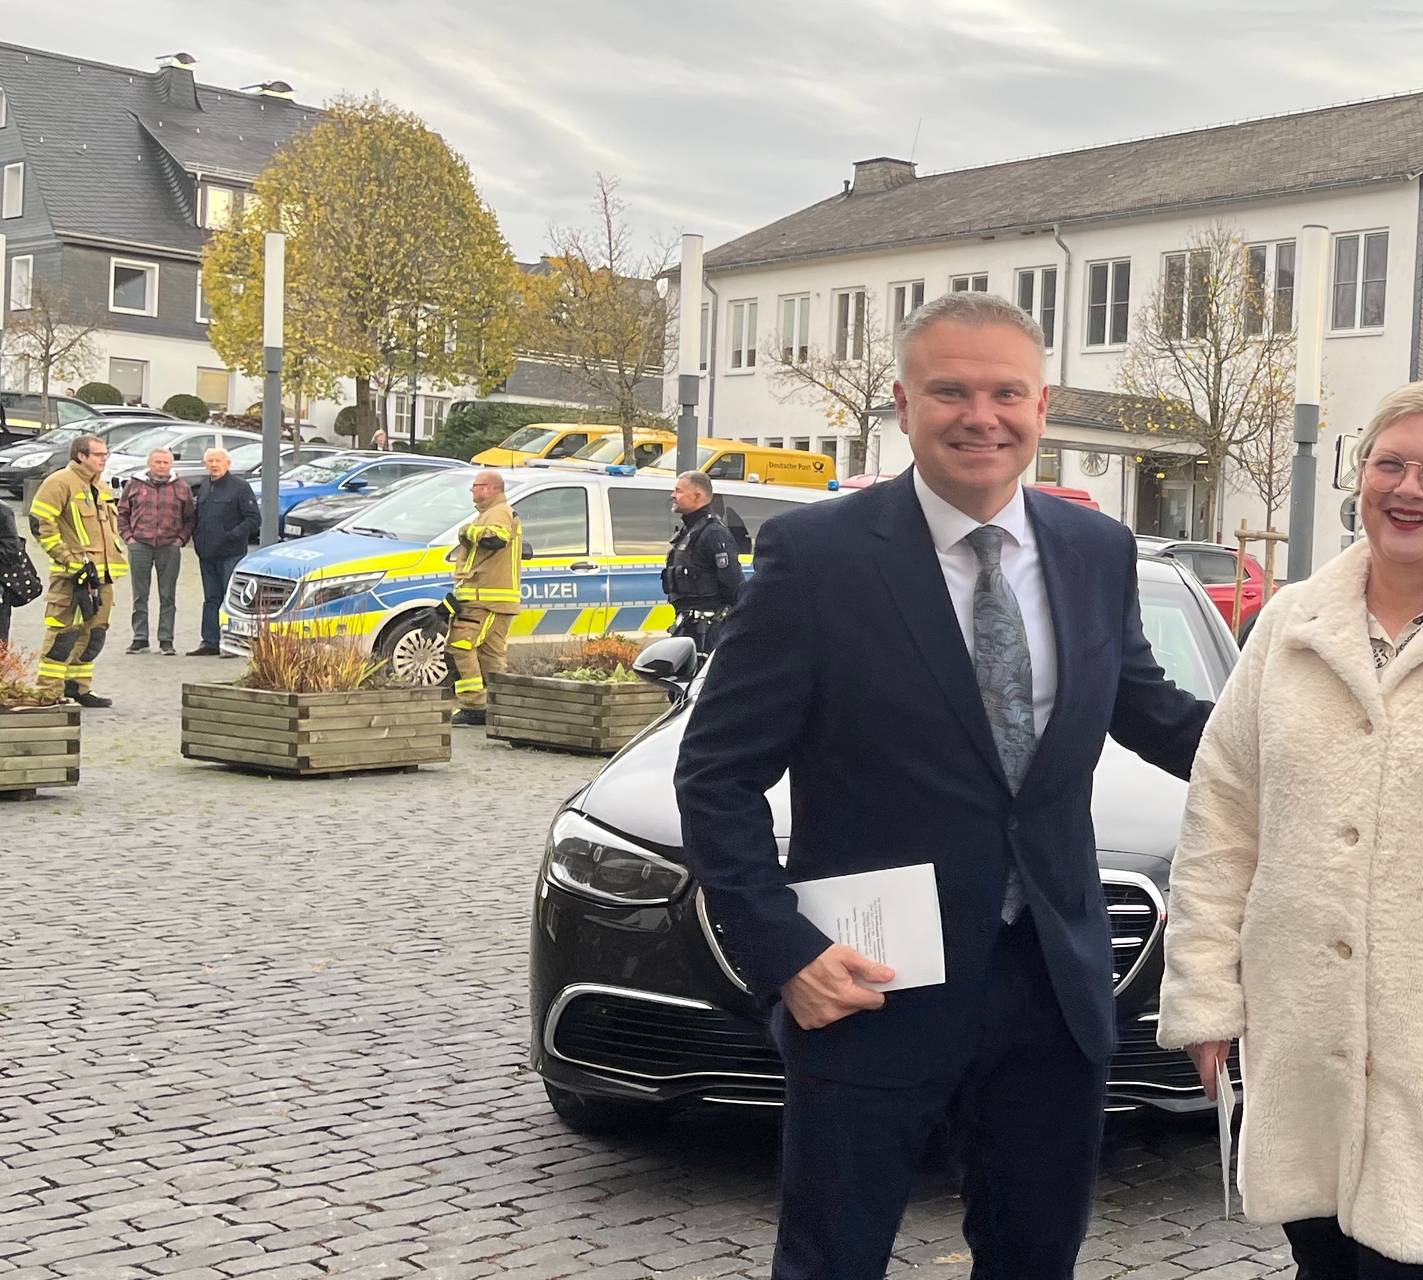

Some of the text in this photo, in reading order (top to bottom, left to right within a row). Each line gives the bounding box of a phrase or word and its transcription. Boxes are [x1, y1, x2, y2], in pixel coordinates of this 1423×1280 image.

[769, 461, 811, 471] Deutsche Post
[520, 583, 577, 599] OLIZEI
